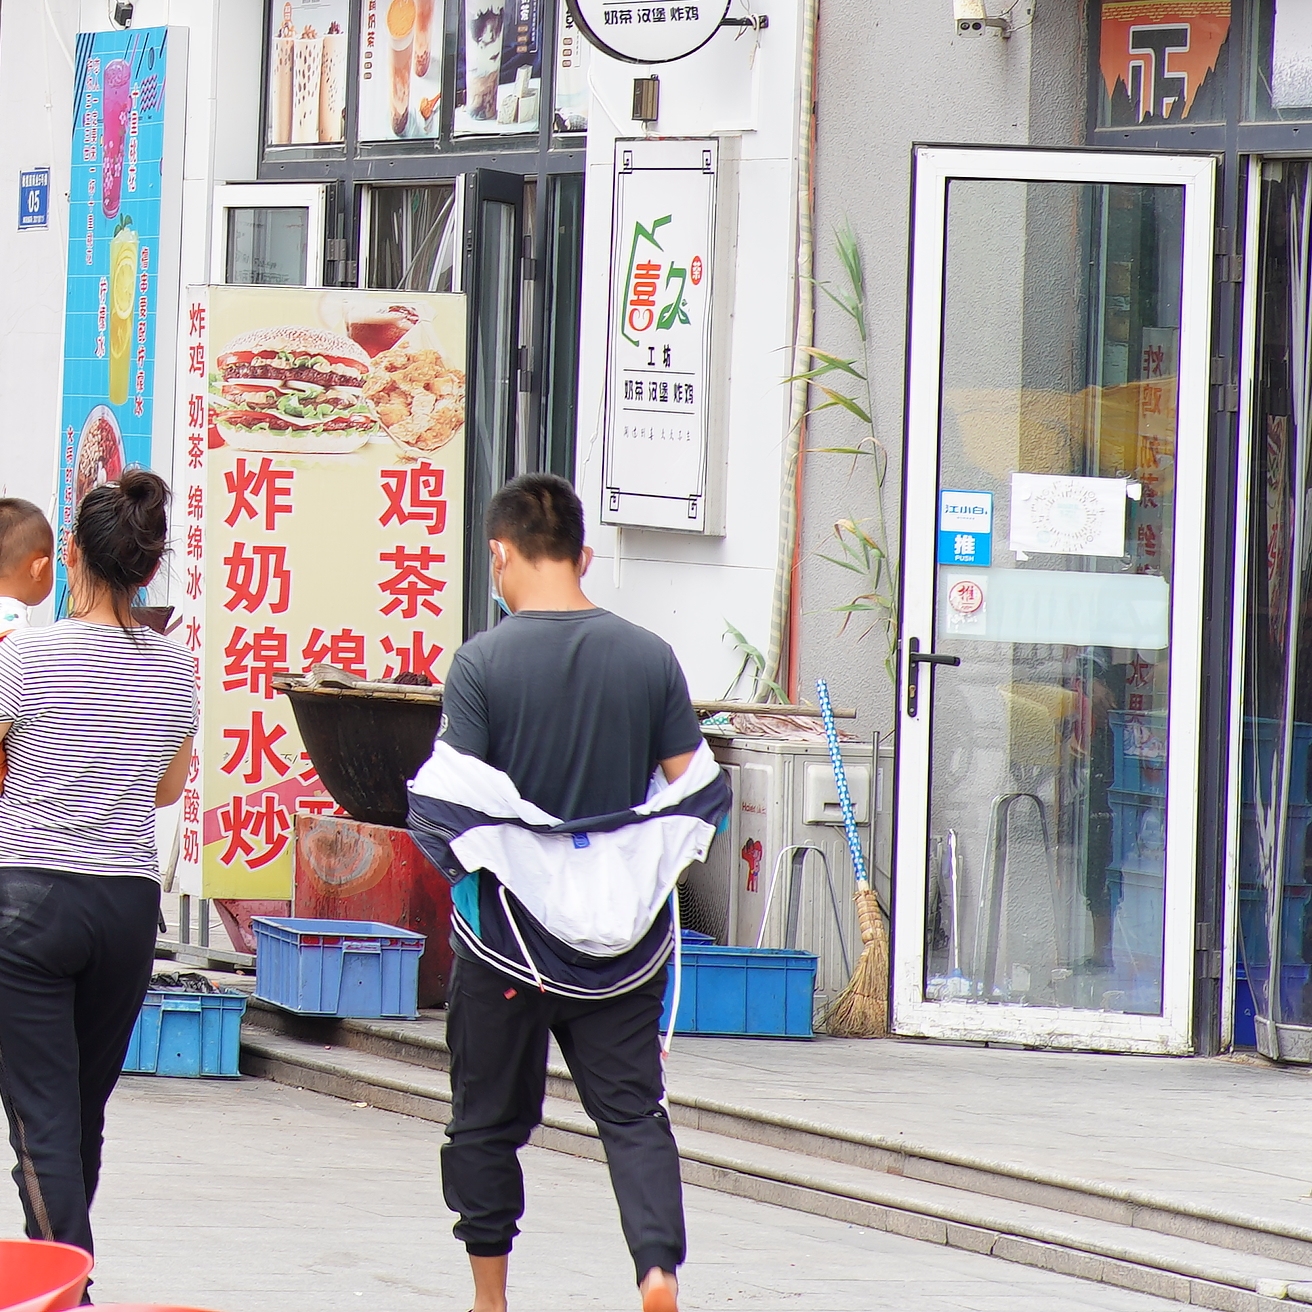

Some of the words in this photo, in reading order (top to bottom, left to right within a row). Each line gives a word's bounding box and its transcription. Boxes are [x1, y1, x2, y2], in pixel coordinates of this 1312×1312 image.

[603, 9, 633, 25] 奶茶
[637, 7, 667, 24] 汉堡
[670, 5, 700, 22] 炸鸡
[28, 188, 41, 213] 05
[188, 302, 206, 378] 炸鸡
[647, 345, 672, 369] 工坊
[623, 380, 644, 402] 奶茶
[648, 381, 669, 403] 汉堡
[673, 383, 694, 405] 炸鸡
[187, 391, 205, 470] 奶茶
[944, 503, 986, 516] 江小白
[185, 484, 205, 602] 绵绵冰
[954, 534, 975, 555] 推
[954, 555, 975, 563] PUSH
